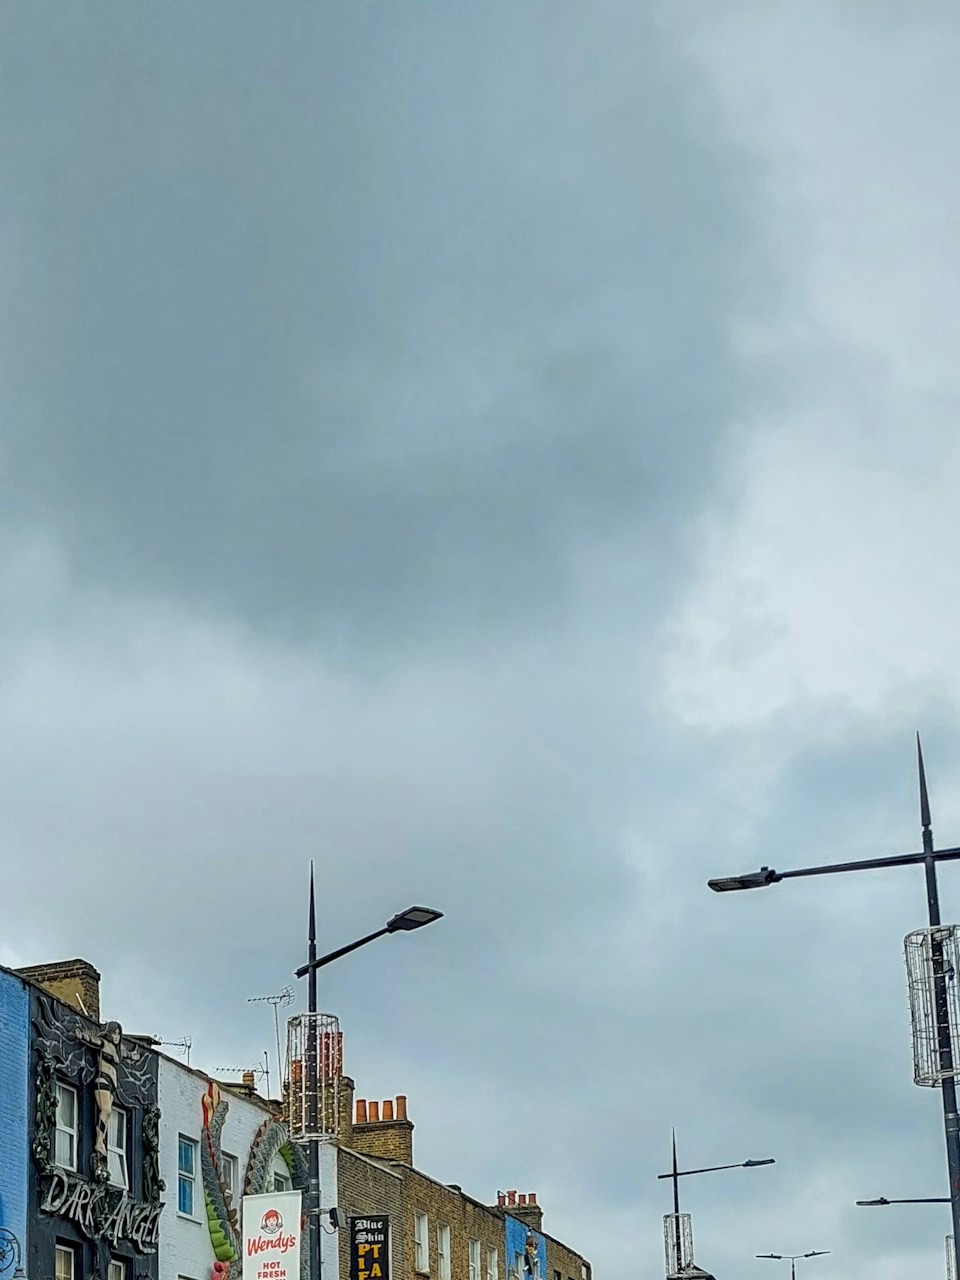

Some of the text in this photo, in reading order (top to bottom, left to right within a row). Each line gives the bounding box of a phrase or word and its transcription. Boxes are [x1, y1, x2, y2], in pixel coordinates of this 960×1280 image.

[354, 1219, 384, 1231] Blue
[246, 1231, 297, 1257] Wendy's
[262, 1261, 281, 1270] HOT
[257, 1269, 286, 1279] FRESH
